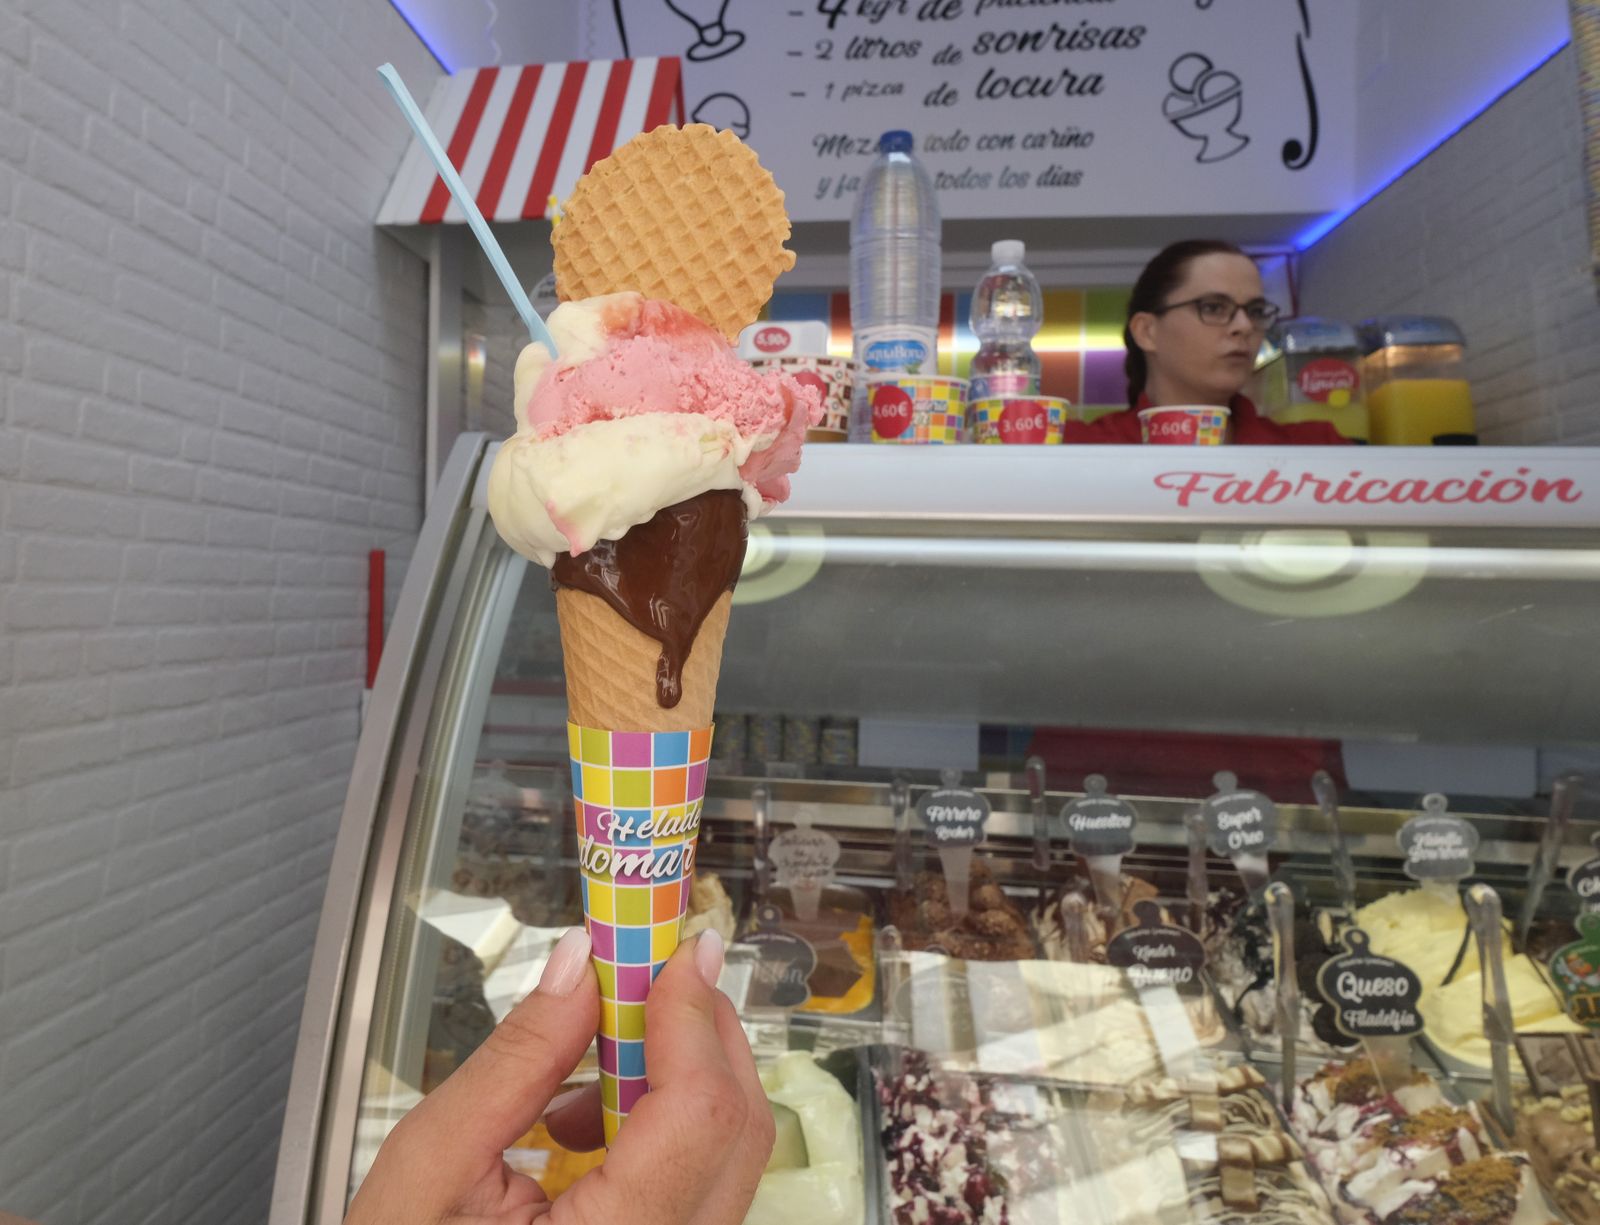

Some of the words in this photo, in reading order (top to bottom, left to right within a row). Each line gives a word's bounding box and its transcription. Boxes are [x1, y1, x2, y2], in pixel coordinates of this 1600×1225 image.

[815, 38, 834, 60] 2
[844, 36, 922, 60] litros
[931, 44, 963, 66] de
[972, 20, 1147, 55] sonrisas
[922, 82, 959, 107] de
[975, 66, 1104, 99] locura
[975, 134, 1015, 150] con
[934, 167, 993, 190] todos
[997, 165, 1031, 188] los
[1153, 467, 1583, 507] Fabricación
[1336, 970, 1410, 1004] Queso
